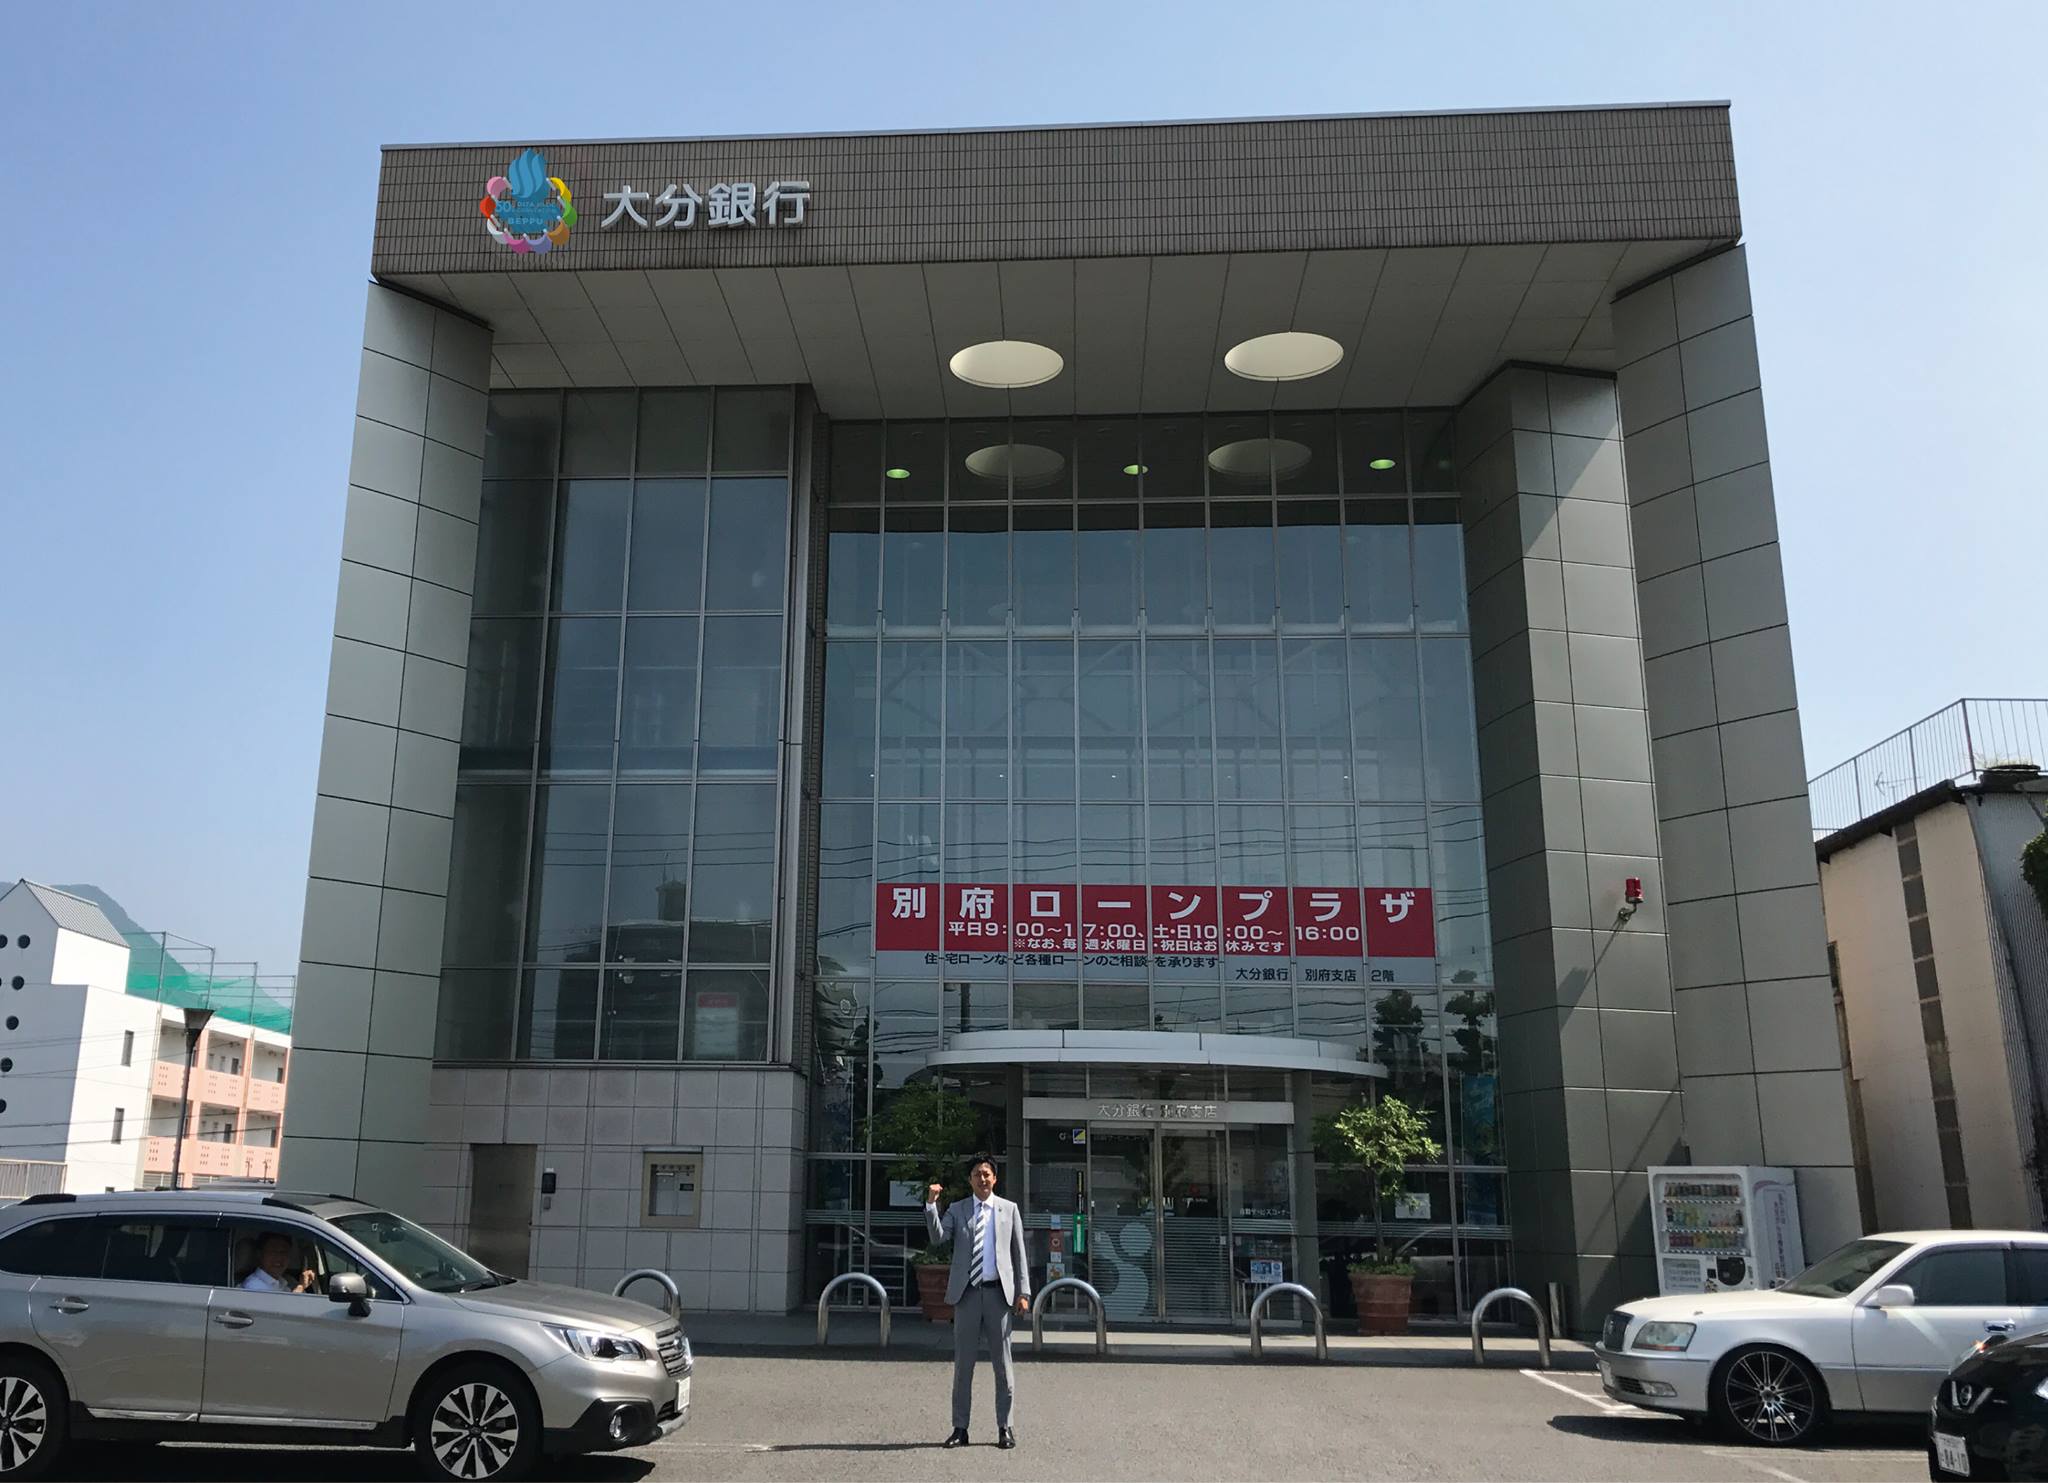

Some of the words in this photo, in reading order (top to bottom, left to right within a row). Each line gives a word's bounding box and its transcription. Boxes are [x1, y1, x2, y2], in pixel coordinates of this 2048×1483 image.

[601, 180, 811, 230] 大分銀行
[891, 886, 1416, 923] 別府ローンプラザ
[1236, 967, 1289, 981] 大分銀行
[1305, 968, 1357, 982] 別府支店
[1371, 970, 1394, 982] 2階
[1097, 1103, 1155, 1118] 大分銀行
